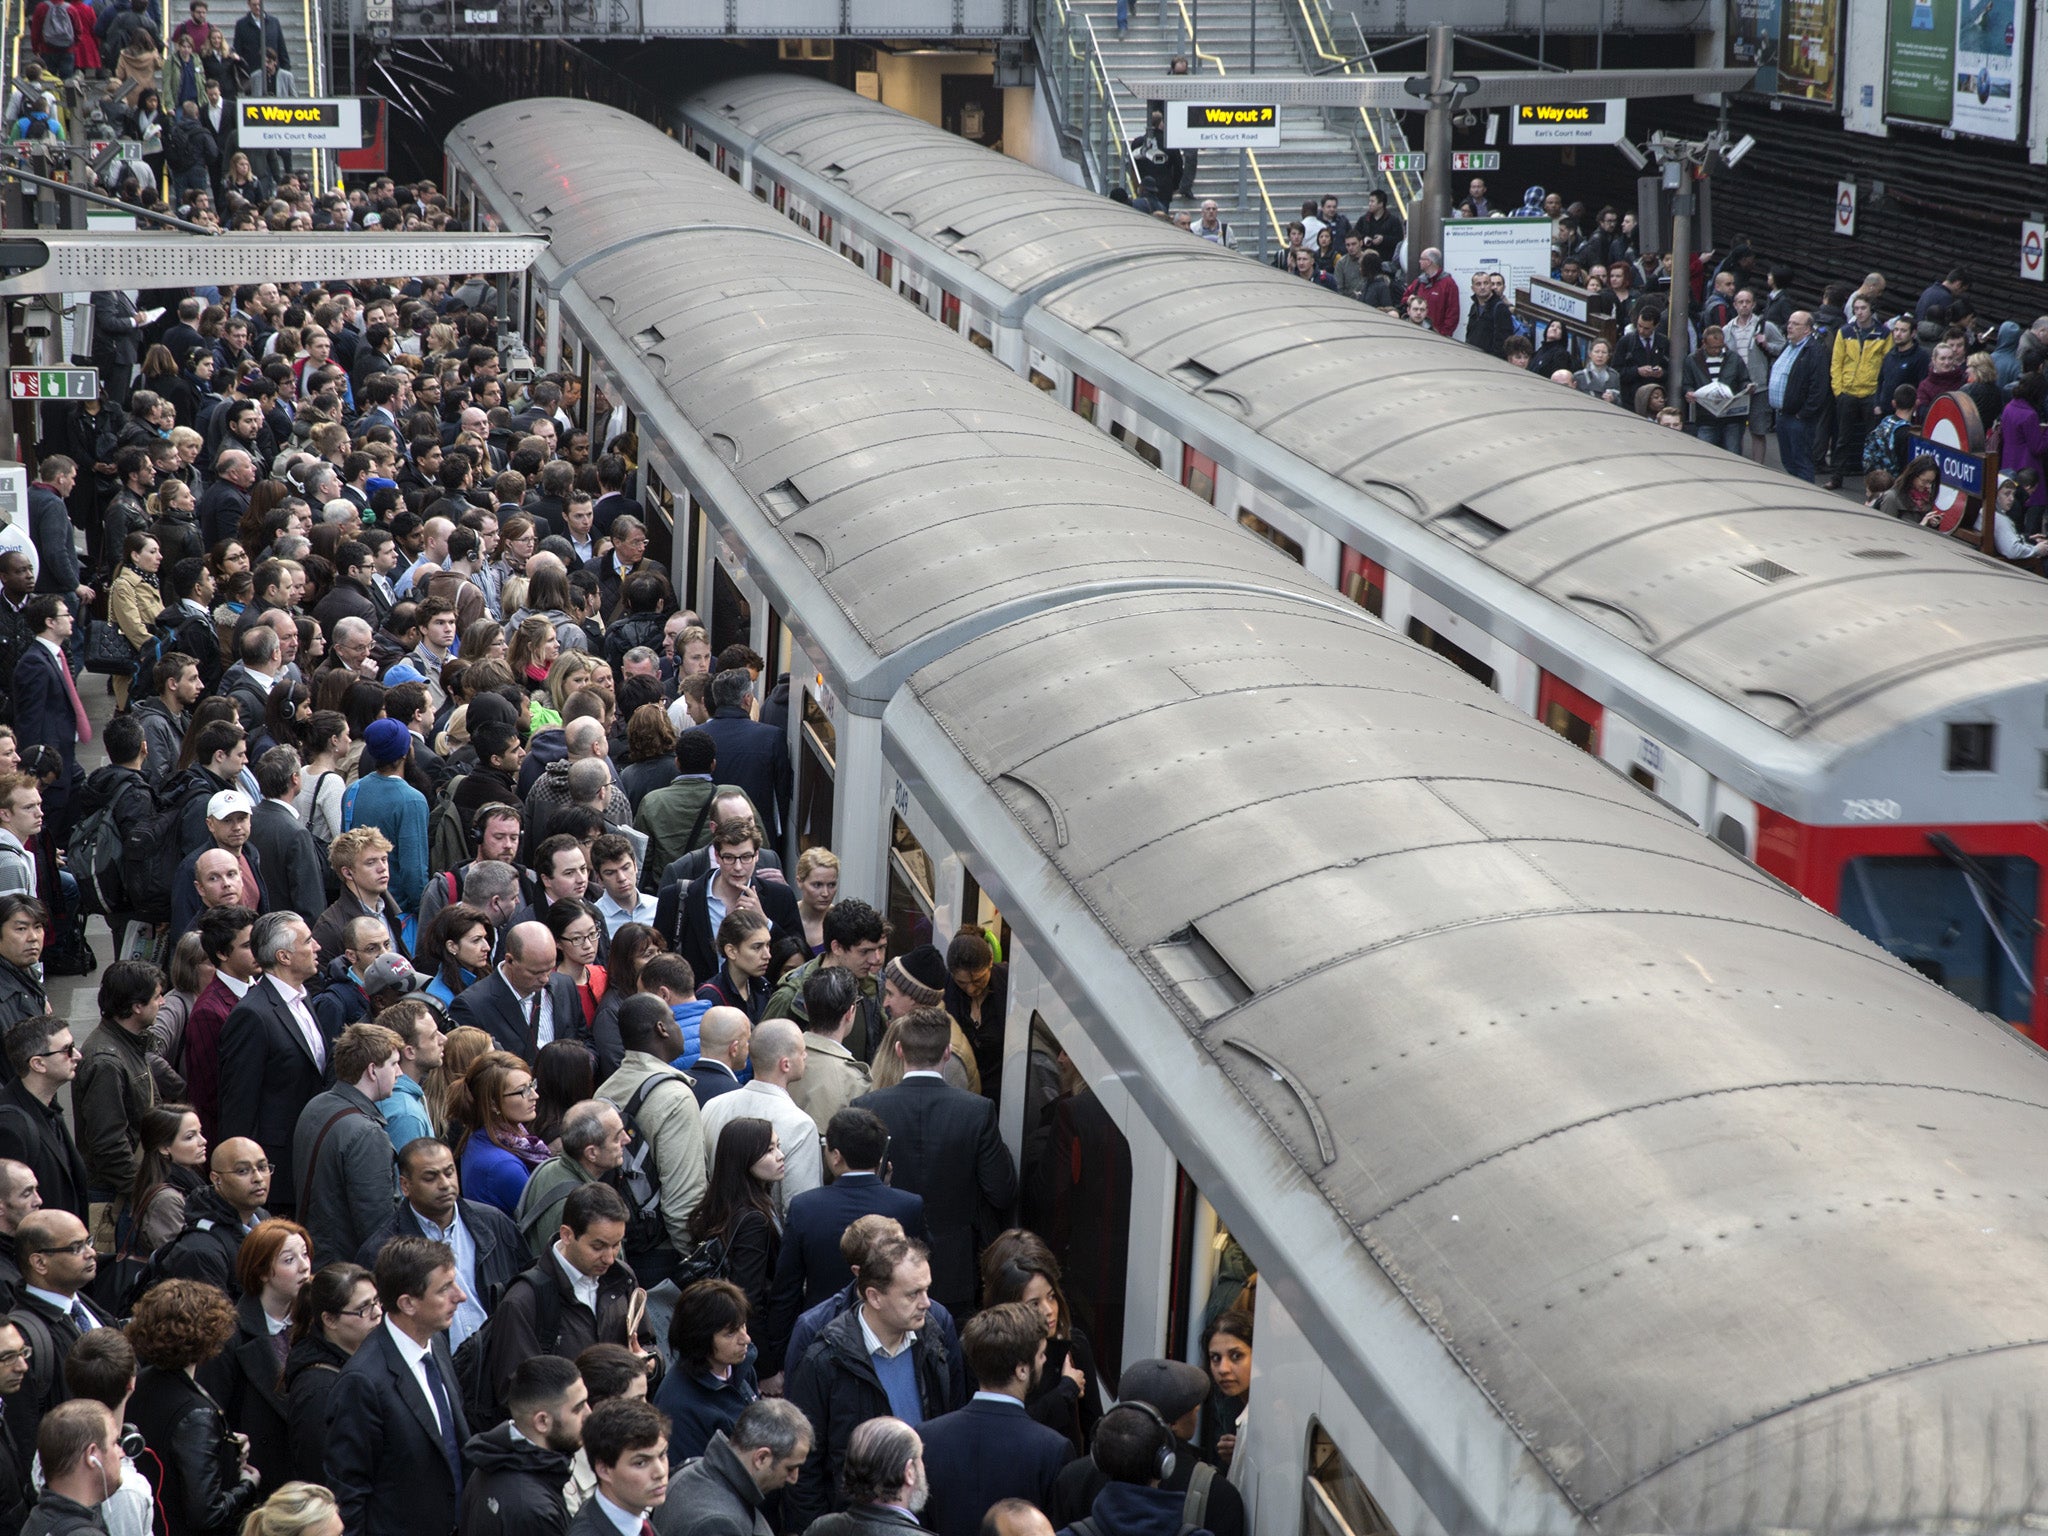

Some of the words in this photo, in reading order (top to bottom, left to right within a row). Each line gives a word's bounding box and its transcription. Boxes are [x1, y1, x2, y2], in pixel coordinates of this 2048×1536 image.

[369, 10, 390, 19] OFF
[261, 106, 293, 124] Way
[294, 107, 321, 121] out
[1205, 109, 1234, 125] Way
[1235, 109, 1258, 122] out
[1536, 106, 1565, 122] Way
[1565, 107, 1589, 120] out
[263, 132, 282, 140] Earl's
[284, 132, 305, 140] Court
[308, 132, 326, 140] Road
[1558, 296, 1576, 313] COURT
[1943, 457, 1976, 484] COURT
[894, 778, 909, 817] 8049
